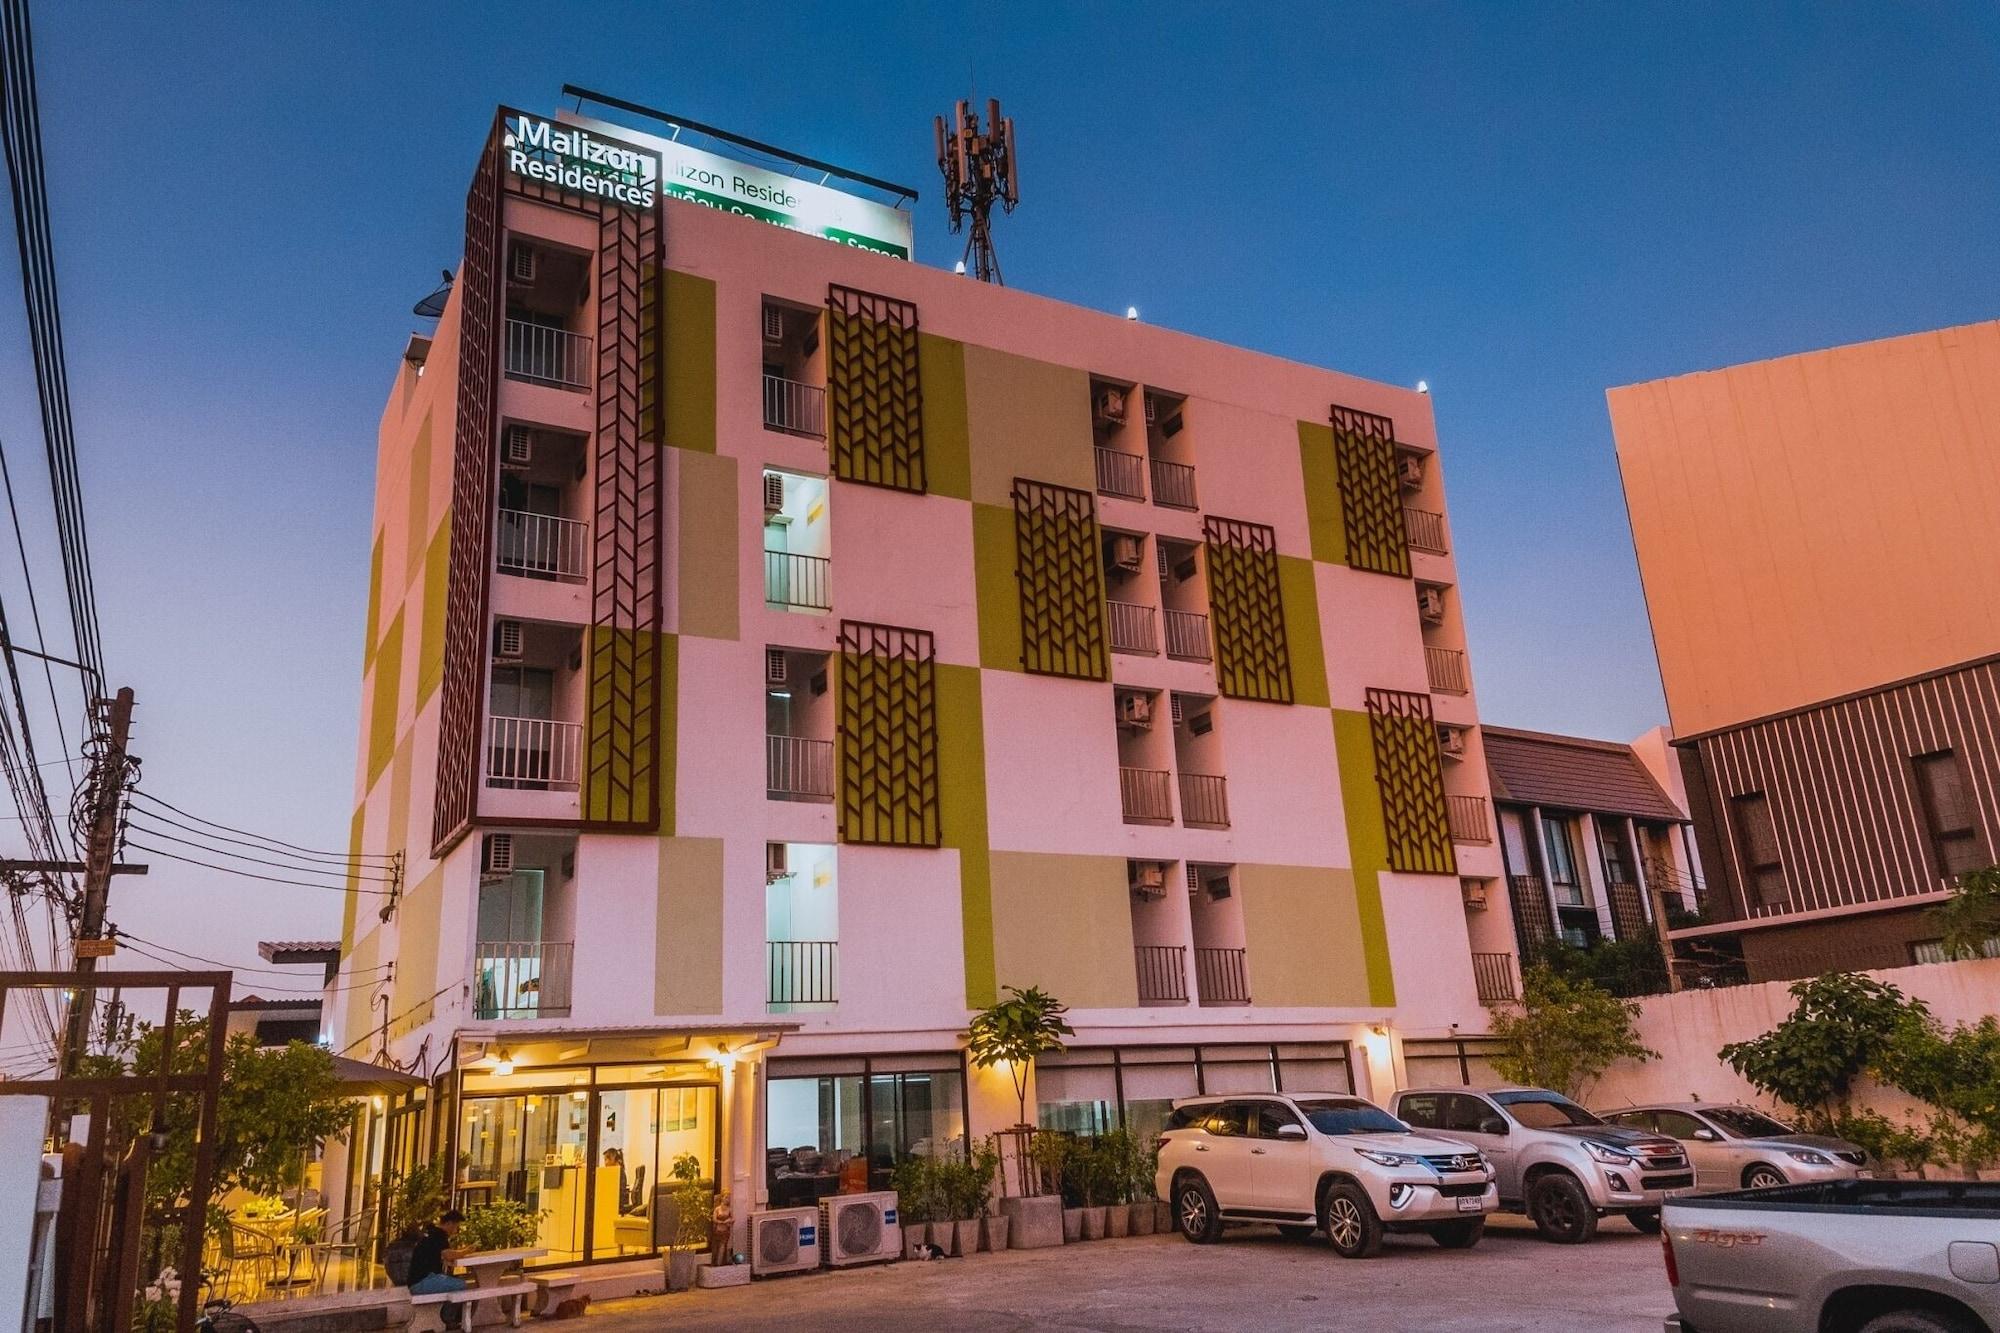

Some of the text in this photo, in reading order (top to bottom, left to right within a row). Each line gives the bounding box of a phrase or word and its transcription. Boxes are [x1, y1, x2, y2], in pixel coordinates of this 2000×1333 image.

[517, 115, 650, 176] Malizon
[510, 150, 654, 208] Residences
[732, 174, 801, 208] Reside
[1693, 1229, 1768, 1248] Tiger
